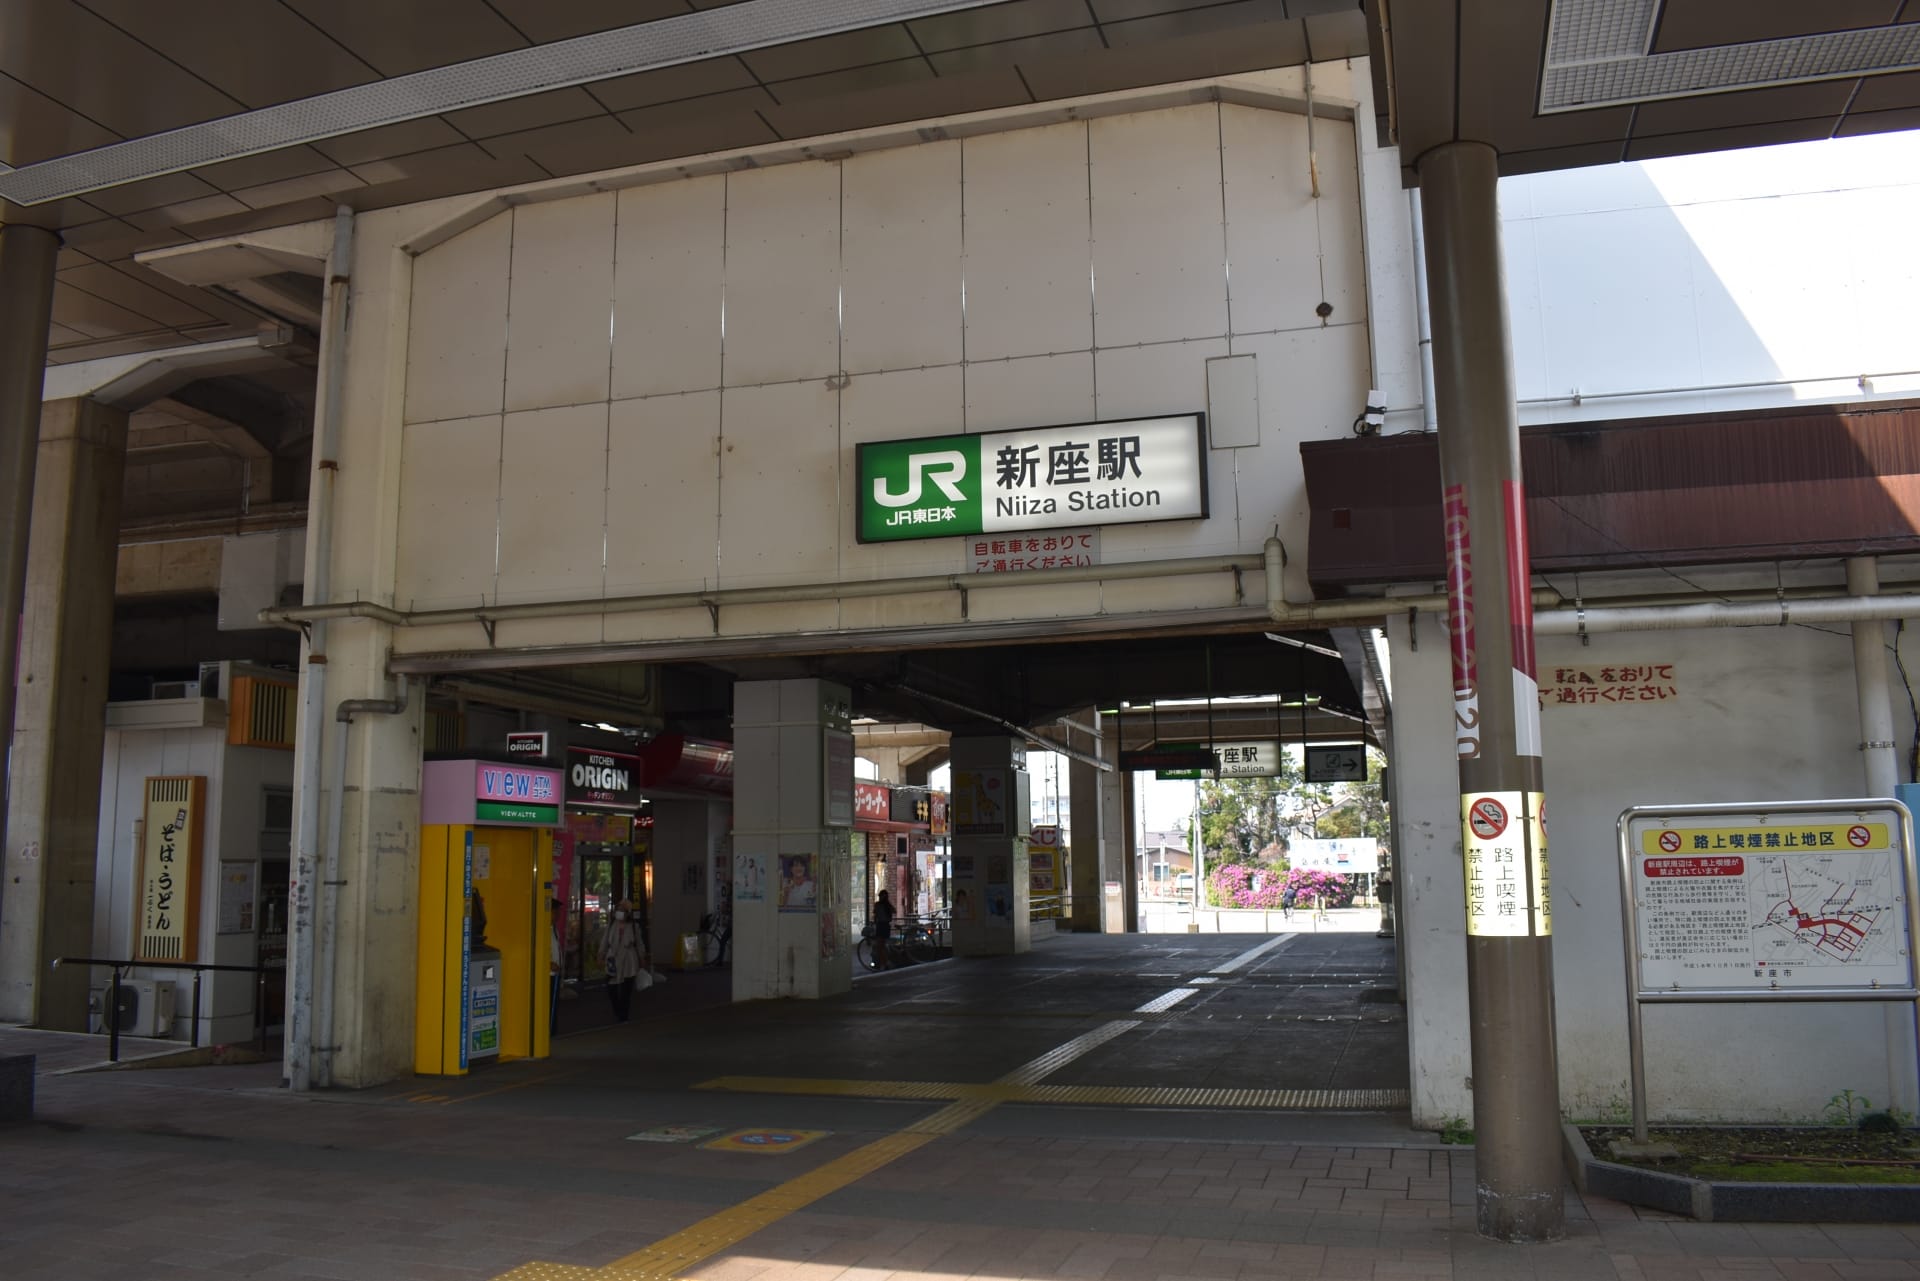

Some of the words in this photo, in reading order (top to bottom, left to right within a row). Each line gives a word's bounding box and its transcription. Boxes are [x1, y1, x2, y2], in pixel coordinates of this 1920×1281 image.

[996, 436, 1142, 490] 新座駅
[874, 451, 967, 507] JR
[996, 496, 1057, 517] Niiza
[1068, 488, 1161, 512] Station
[886, 506, 956, 526] JR東日本
[975, 535, 1092, 556] 自転車をおりて
[589, 754, 614, 766] KITCHEN
[1232, 765, 1264, 774] Station
[534, 776, 551, 788] ATM
[572, 764, 628, 791] ORIGIN
[533, 789, 552, 799] コーナー
[1694, 832, 1835, 849] 路上喫煙禁止地区
[156, 824, 175, 930] そば・うどん
[1468, 848, 1486, 916] 禁止地区
[1495, 848, 1516, 916] 路上喫煙
